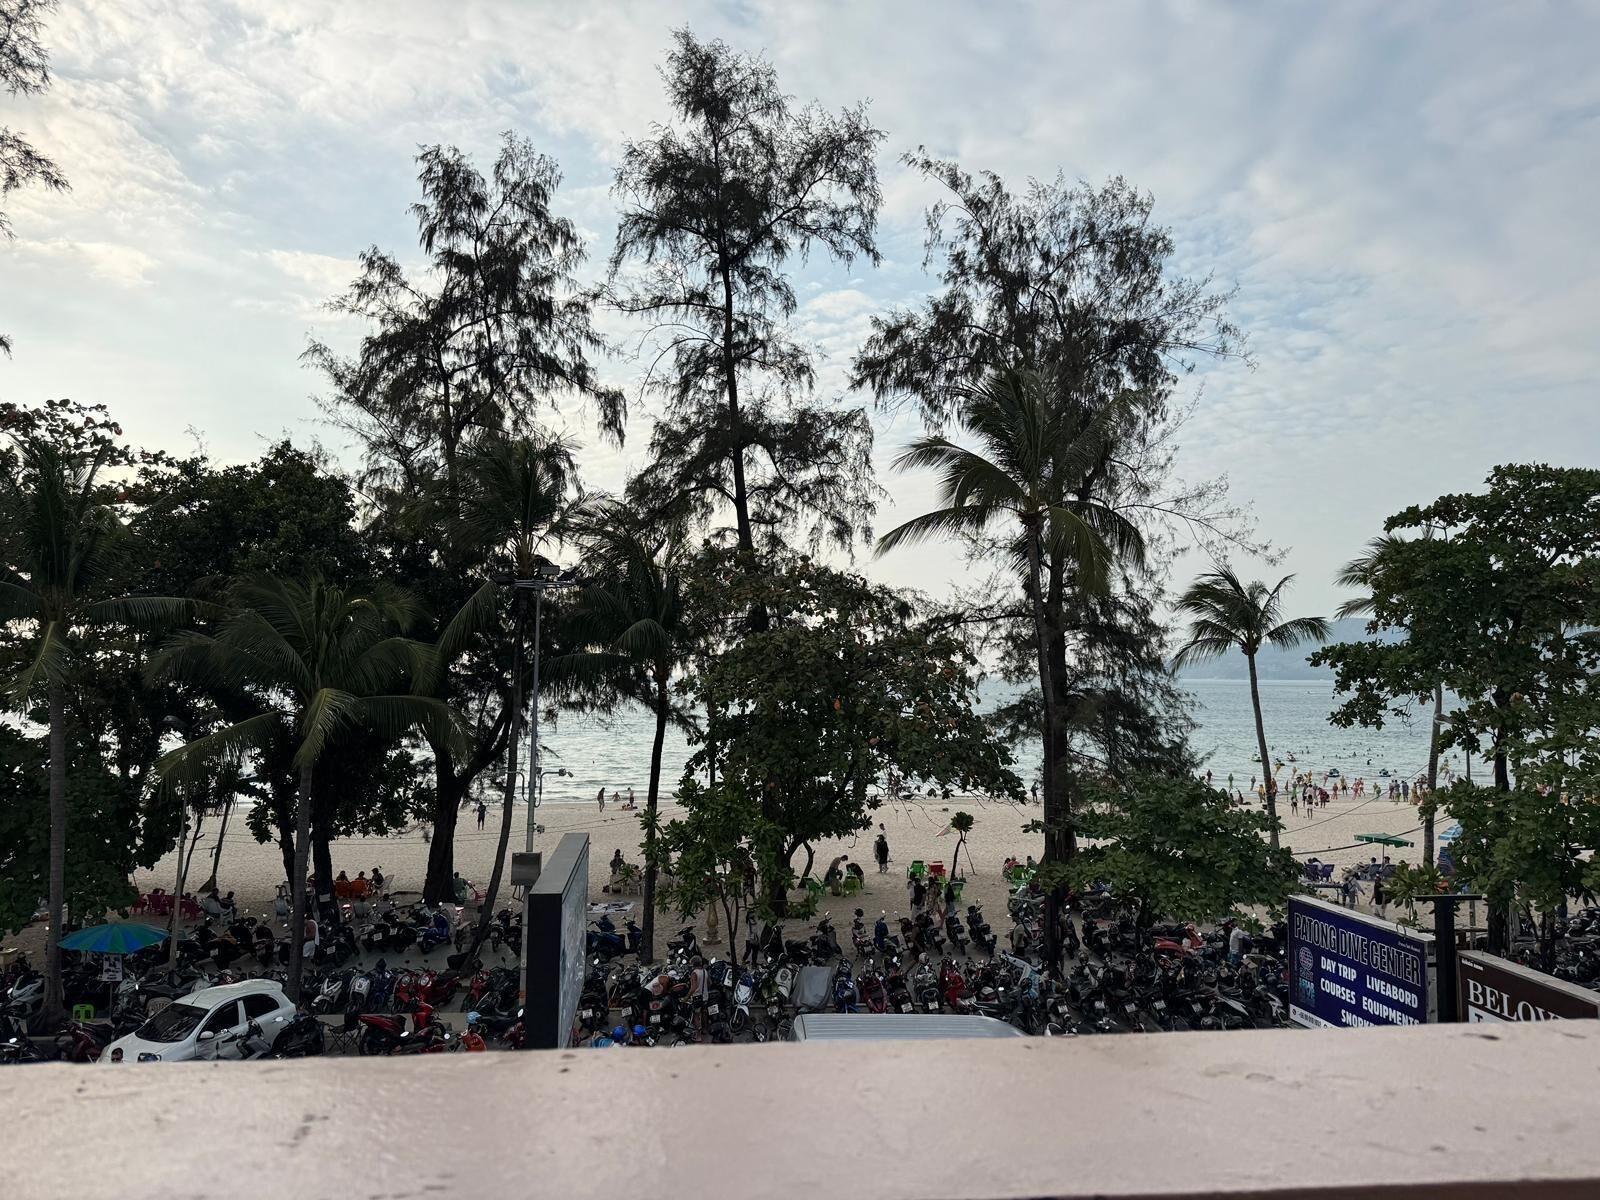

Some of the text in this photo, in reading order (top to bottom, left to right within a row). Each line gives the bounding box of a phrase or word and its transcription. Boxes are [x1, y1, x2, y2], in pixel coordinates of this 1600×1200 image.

[1294, 912, 1337, 953] PATONG
[1339, 929, 1368, 966] DIVE
[1369, 940, 1421, 987] CENTER
[1320, 956, 1337, 974] DAY
[1338, 962, 1357, 982] TRIP
[1320, 977, 1356, 1005] COURSES
[1366, 974, 1418, 1009] LIVEABORD
[1362, 995, 1420, 1026] EQUIPMENTS
